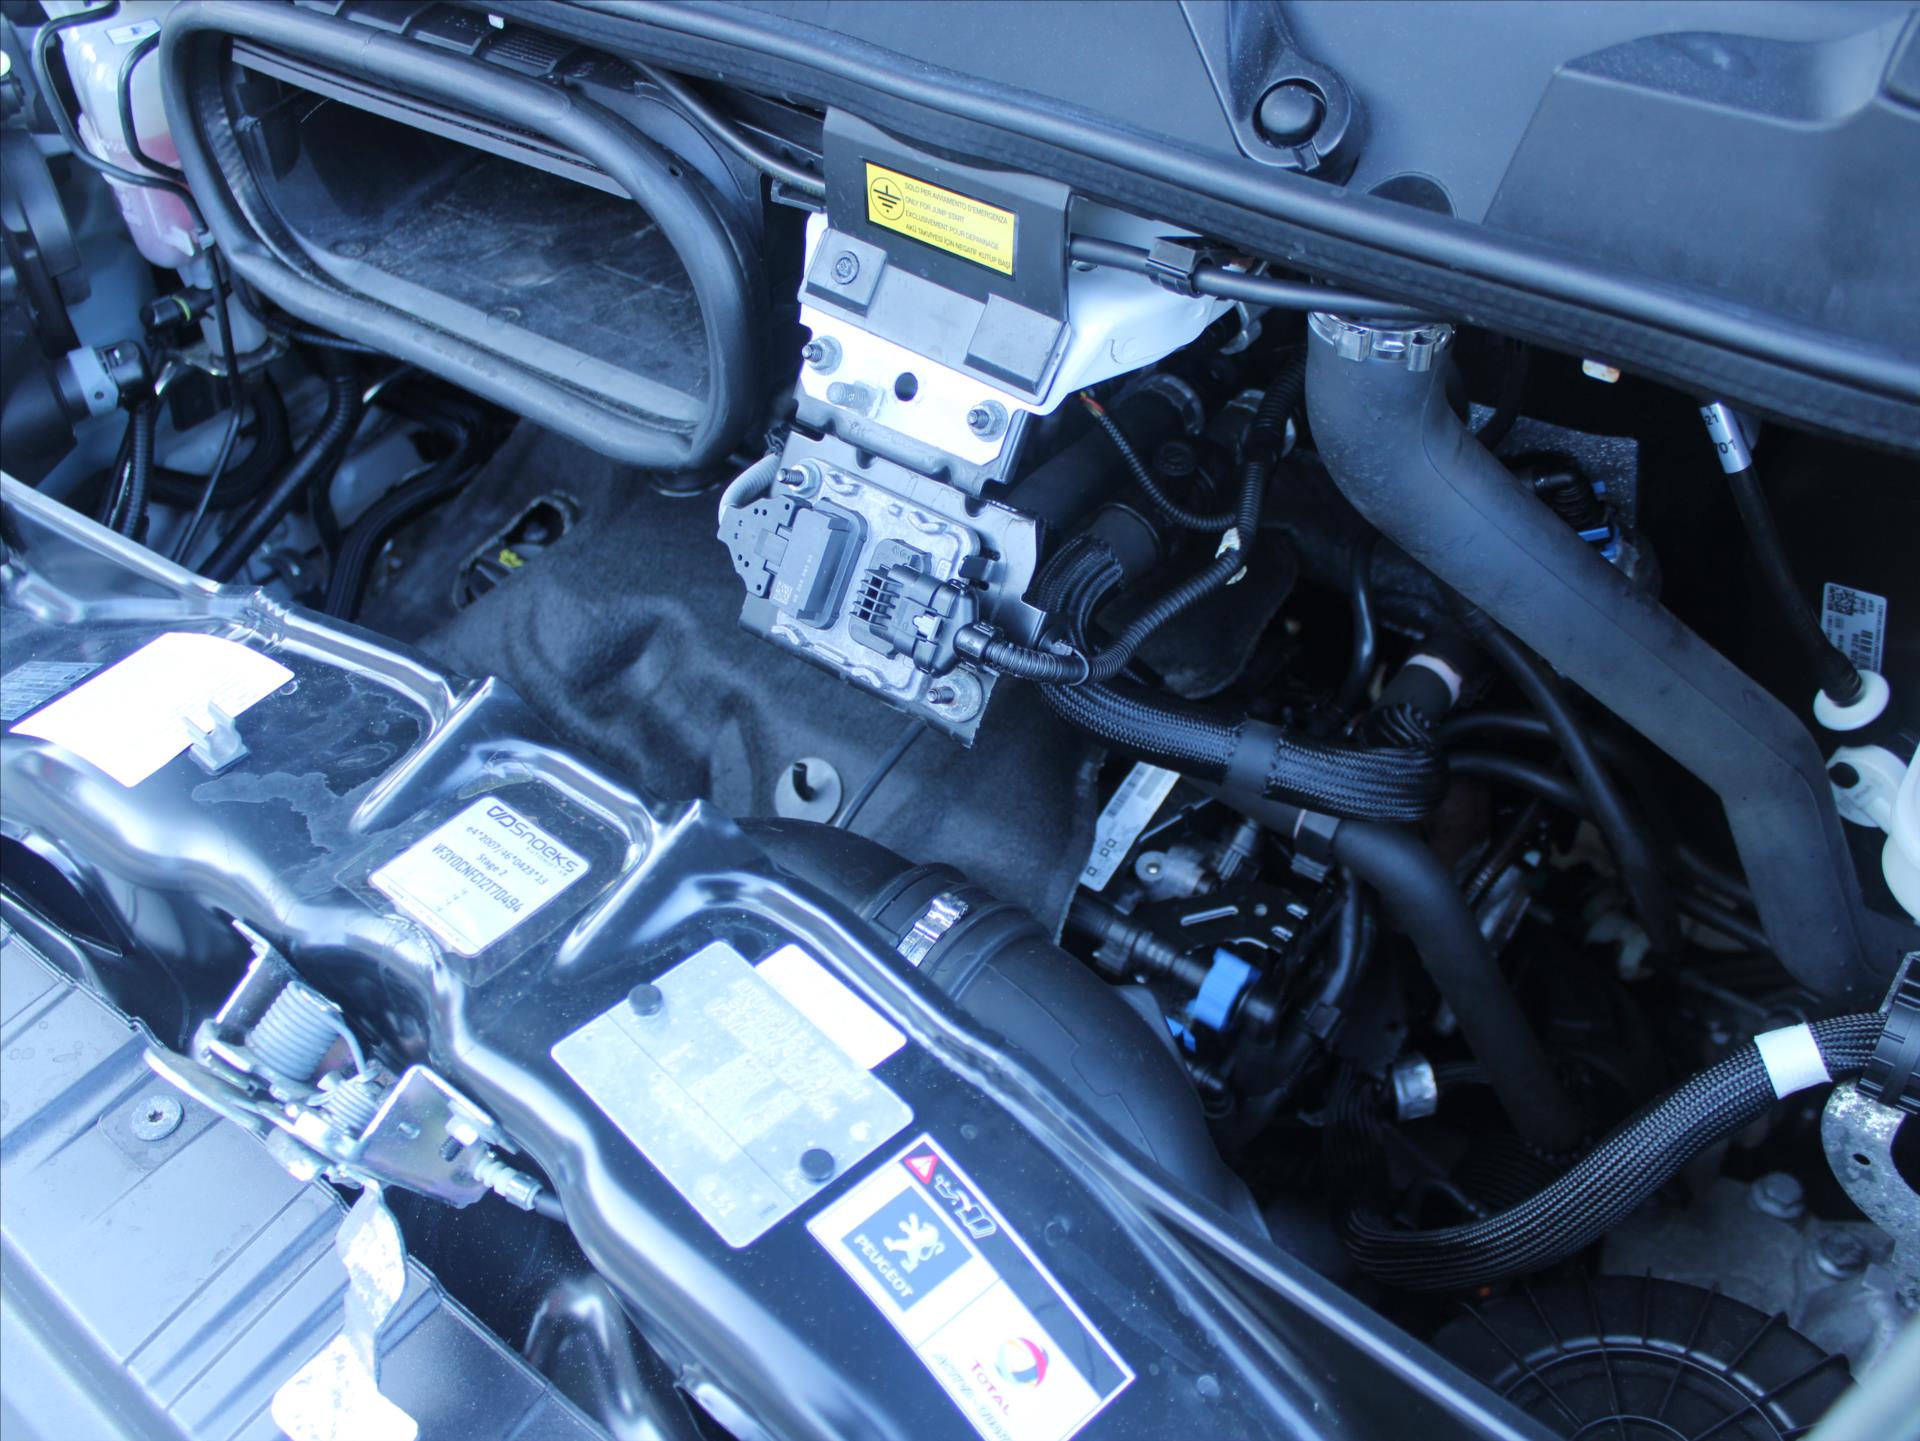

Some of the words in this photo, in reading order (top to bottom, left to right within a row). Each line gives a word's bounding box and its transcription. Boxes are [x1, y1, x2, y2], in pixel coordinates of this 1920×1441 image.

[476, 853, 500, 872] Stage
[854, 1233, 914, 1297] PEUGEOT
[971, 1360, 1010, 1416] TOTAL
